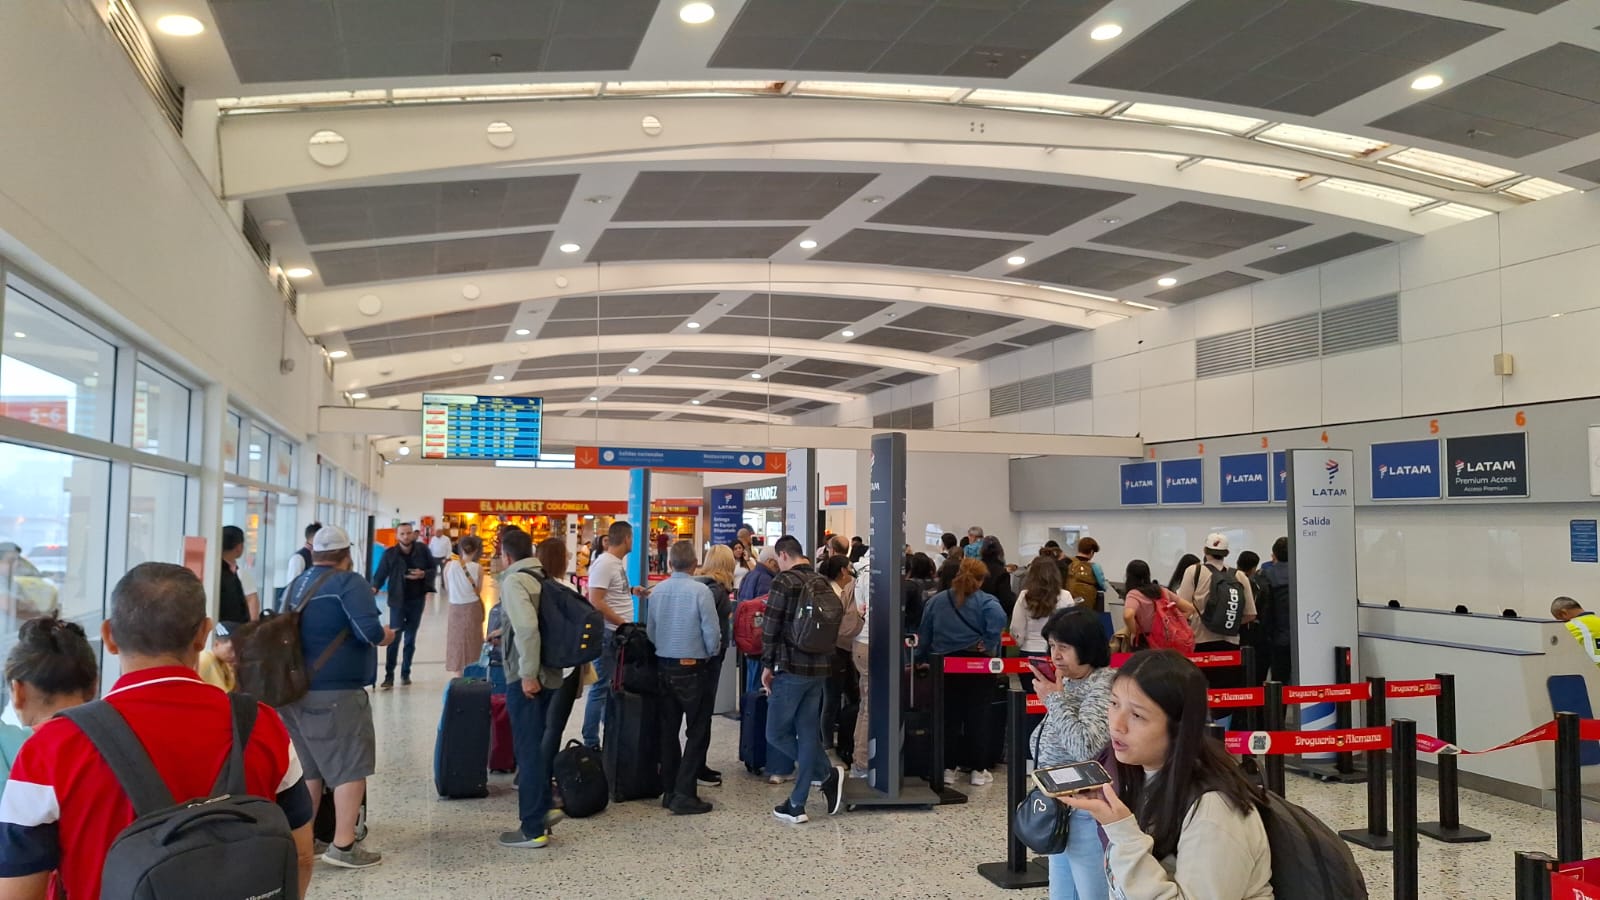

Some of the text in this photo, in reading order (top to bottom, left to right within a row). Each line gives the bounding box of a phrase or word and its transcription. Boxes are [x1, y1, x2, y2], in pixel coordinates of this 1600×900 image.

[1515, 411, 1526, 427] 6
[1430, 420, 1439, 434] 5
[1262, 437, 1268, 448] 3
[1321, 431, 1328, 443] 4
[1150, 448, 1156, 459] 1
[1198, 443, 1204, 454] 2
[1390, 464, 1431, 476] LATAM
[1467, 460, 1516, 472] LATAM
[1172, 478, 1198, 486] LATAM
[1232, 474, 1262, 482] LATAM
[1456, 476, 1488, 484] Premium
[1130, 480, 1152, 488] LATAM
[480, 500, 492, 511] EL
[496, 501, 544, 511] MARKET
[1302, 517, 1330, 525] Salida
[1225, 588, 1238, 629] adidas
